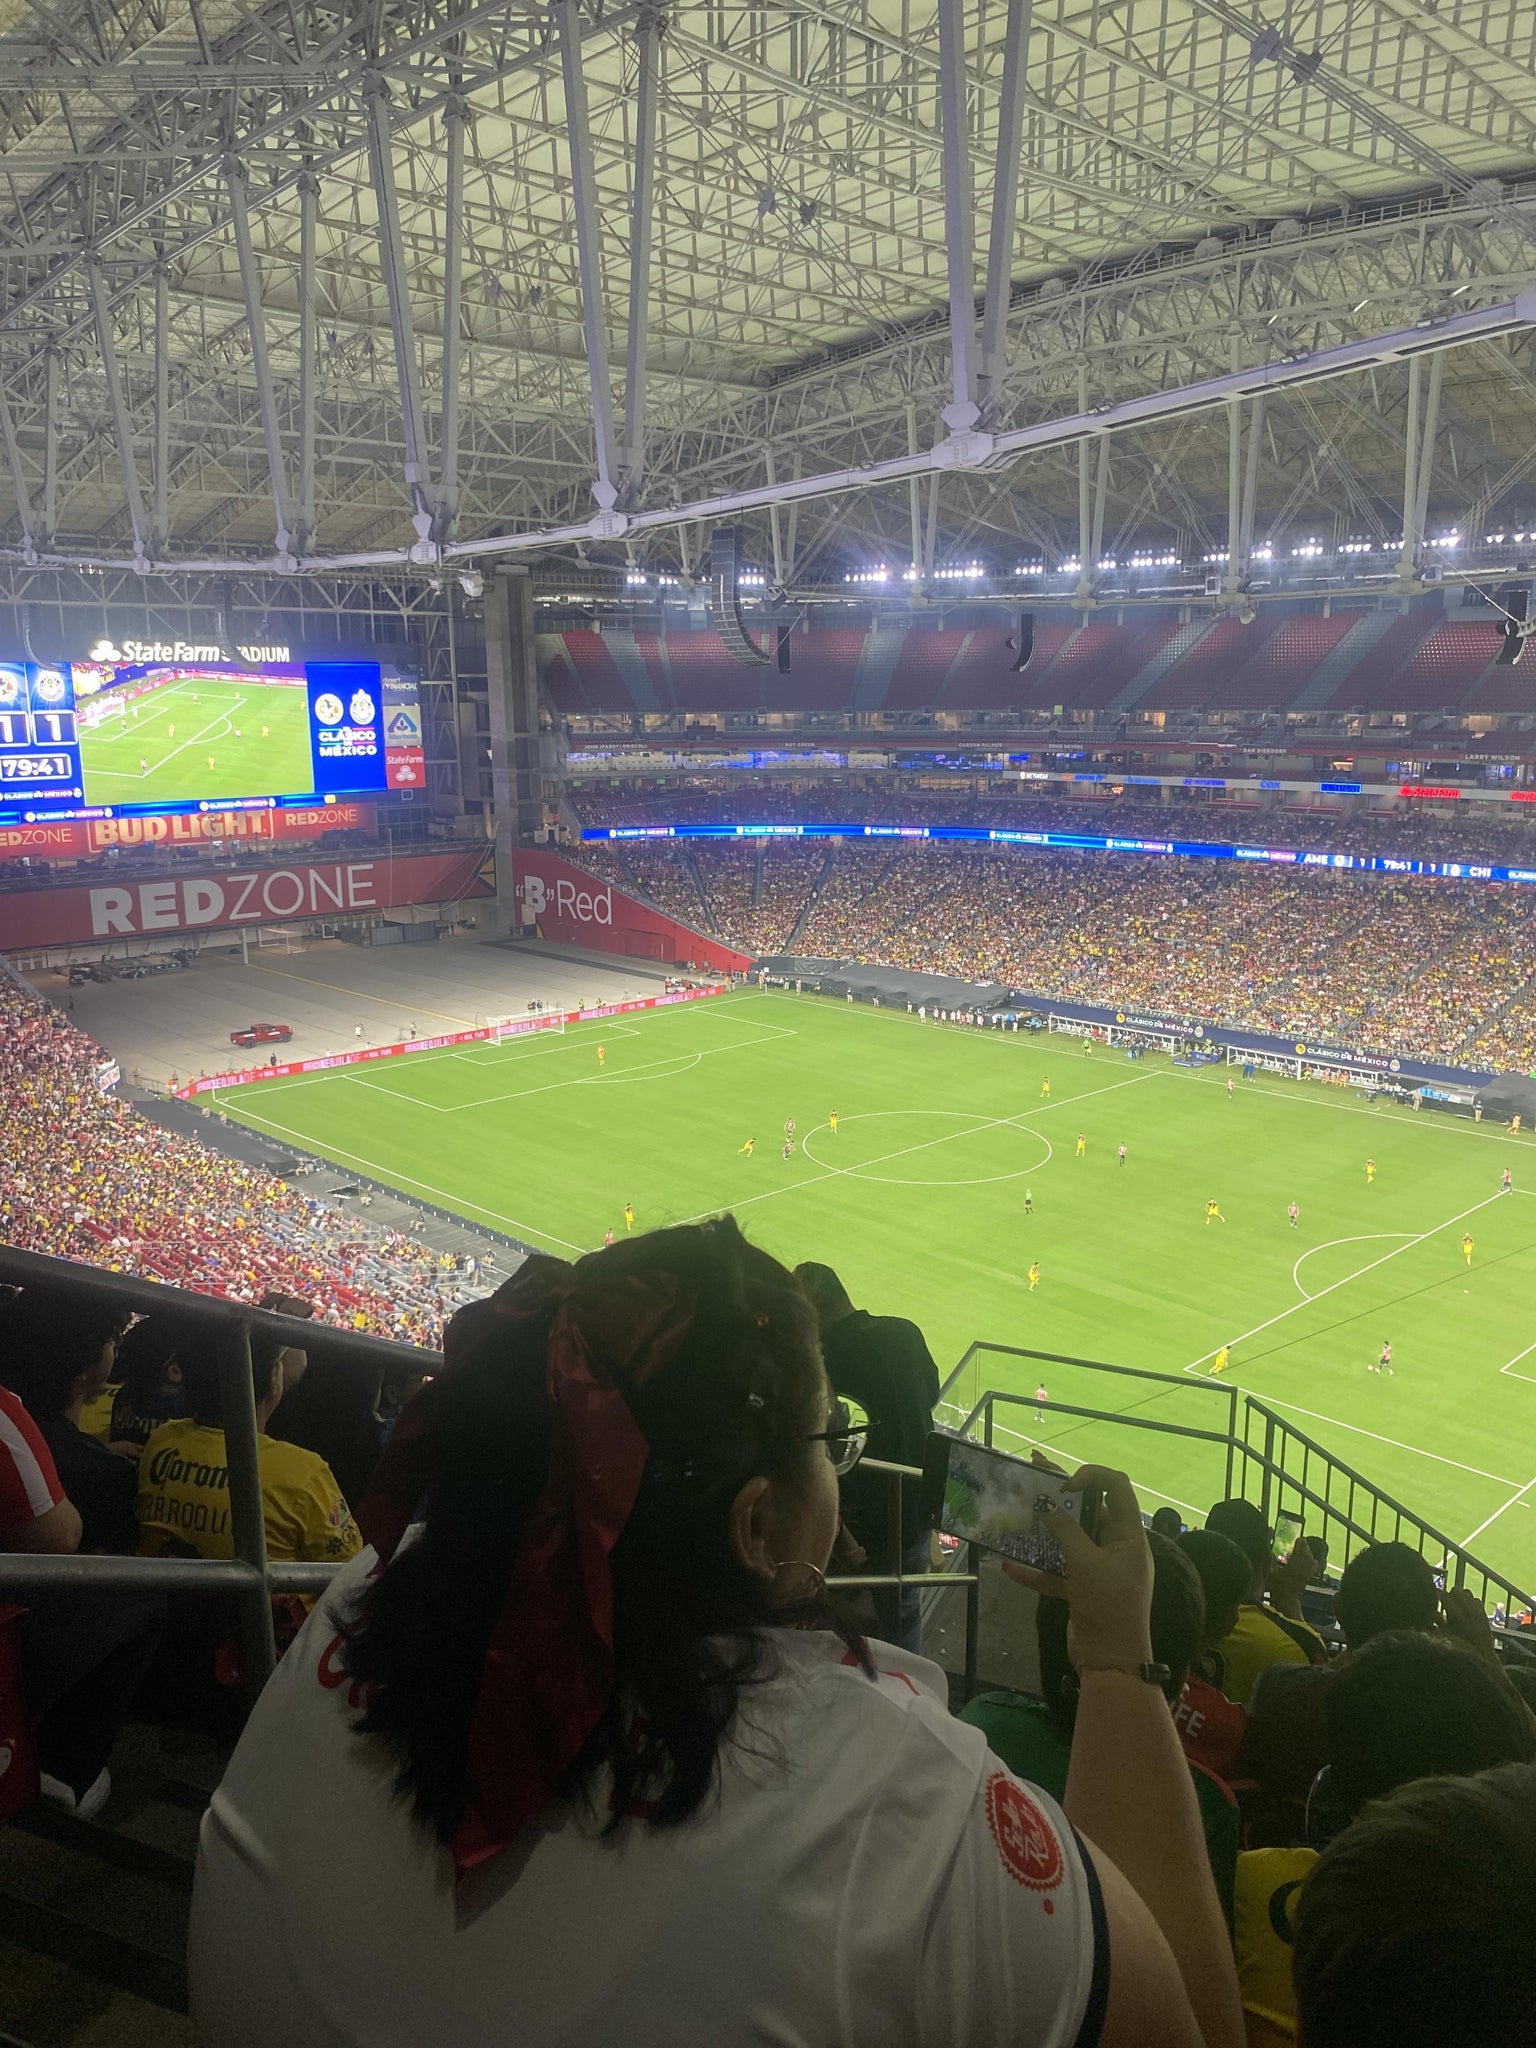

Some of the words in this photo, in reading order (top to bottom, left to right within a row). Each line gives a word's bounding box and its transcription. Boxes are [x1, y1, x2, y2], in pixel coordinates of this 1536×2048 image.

[122, 641, 219, 662] StateFarm
[45, 714, 61, 741] 1
[2, 758, 64, 776] 79:41
[95, 816, 167, 845] BUD
[172, 809, 265, 839] LIGHT
[285, 809, 358, 826] REDZONE
[0, 828, 72, 847] EDZONE
[1304, 853, 1328, 864] AME
[1469, 867, 1492, 878] CHI
[89, 863, 376, 936] REDZONE
[150, 1447, 228, 1491] Coron
